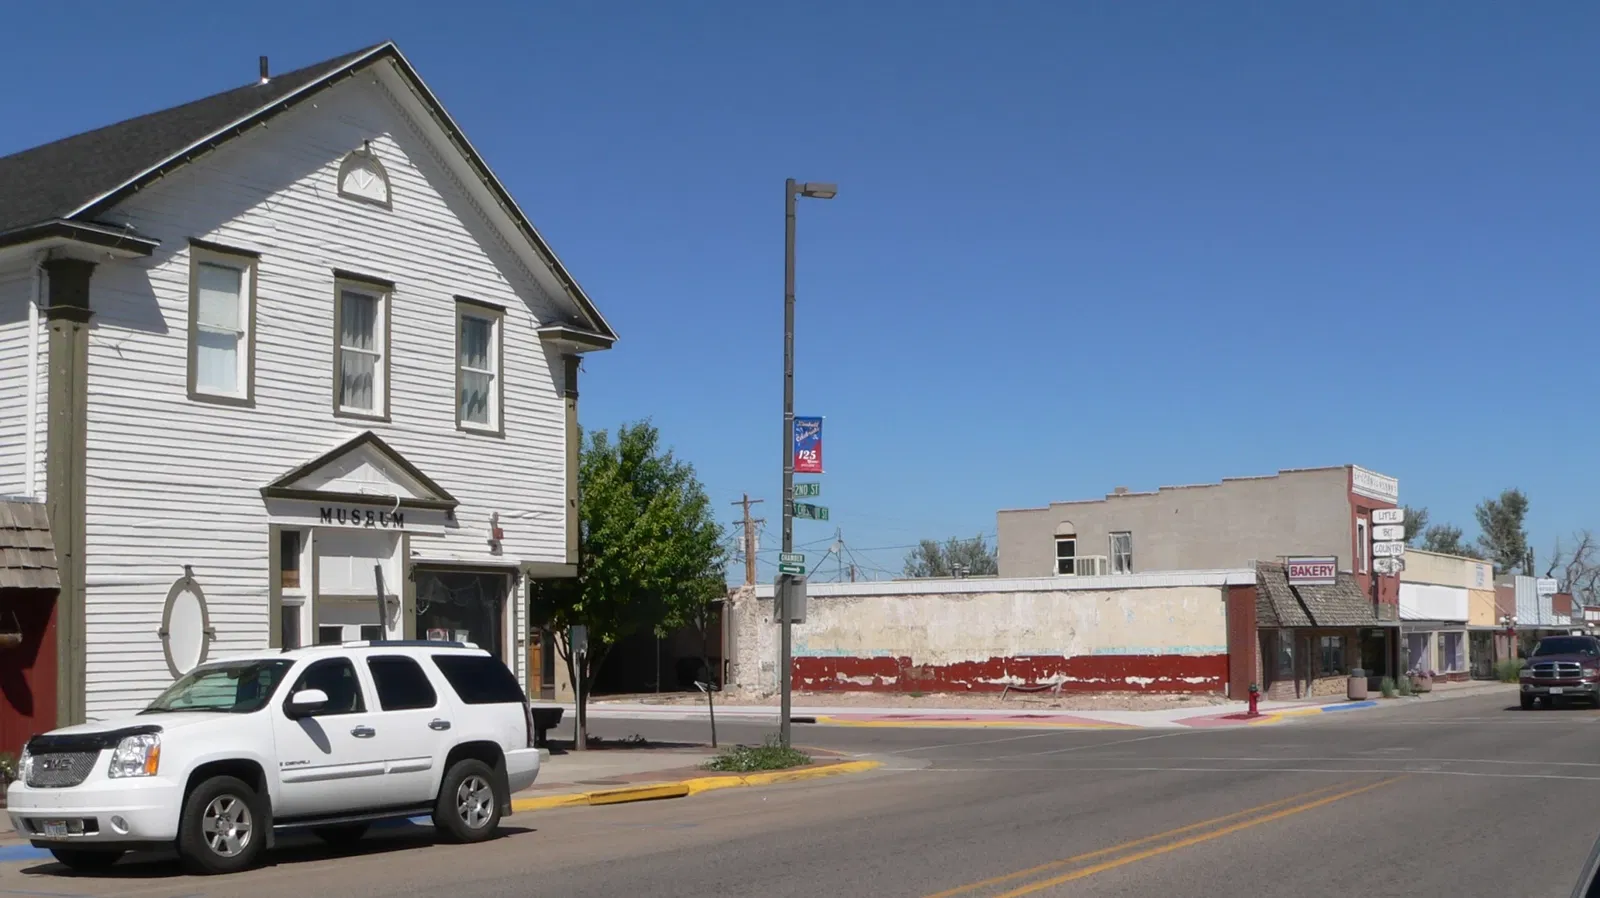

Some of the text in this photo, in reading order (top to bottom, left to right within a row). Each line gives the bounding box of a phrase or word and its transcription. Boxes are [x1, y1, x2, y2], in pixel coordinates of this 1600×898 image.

[798, 449, 817, 460] 125
[795, 483, 819, 496] 2ND ST
[320, 507, 404, 529] MUSEUM
[1374, 543, 1403, 554] COUNTRY
[1290, 566, 1334, 576] BAKERY
